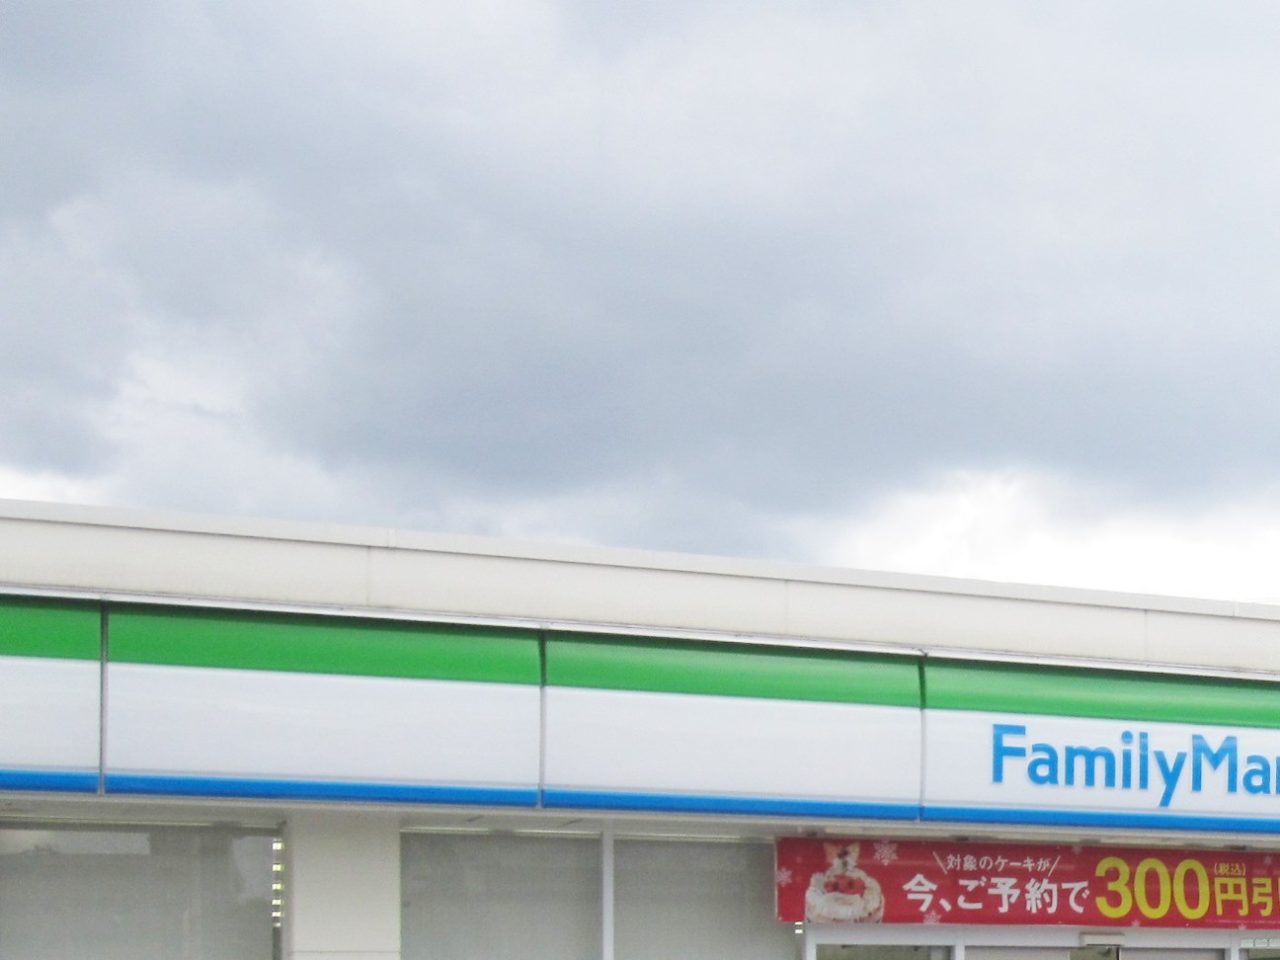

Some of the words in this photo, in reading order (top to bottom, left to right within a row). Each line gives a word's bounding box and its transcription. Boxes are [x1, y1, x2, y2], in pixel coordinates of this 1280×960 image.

[946, 853, 1051, 873] 対象のケーキが
[902, 873, 1090, 914] 今、ご予約で
